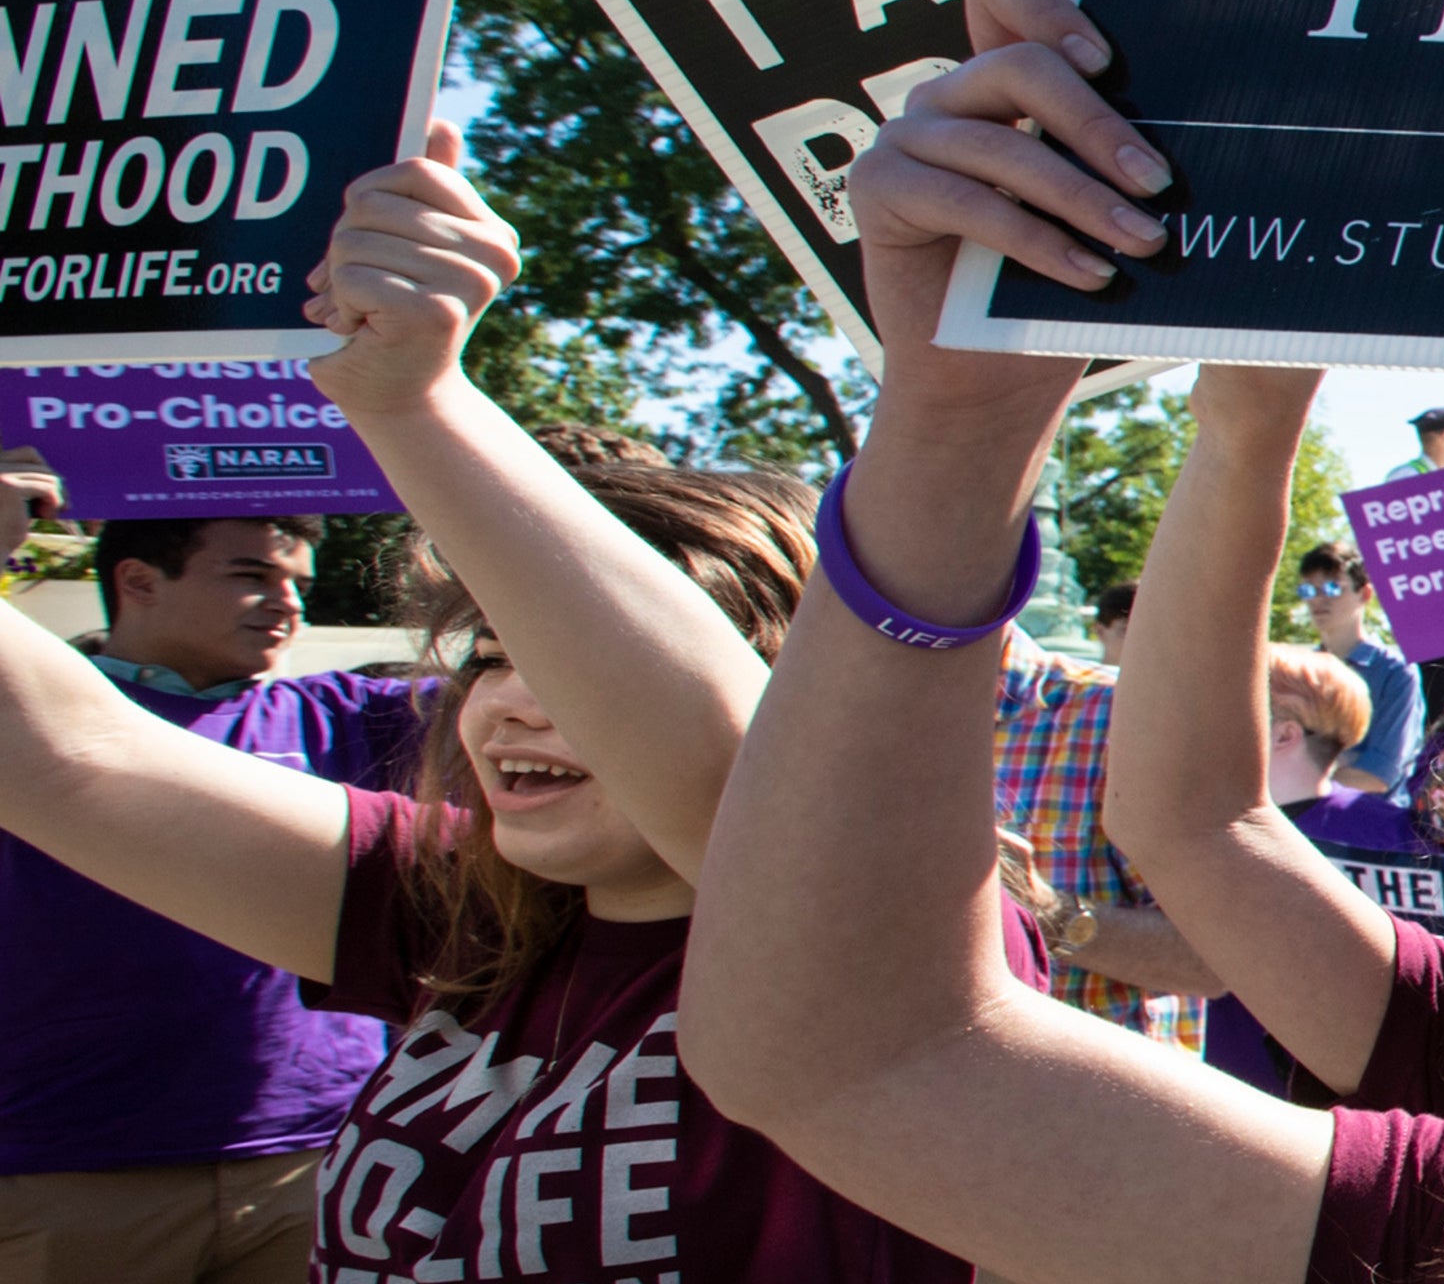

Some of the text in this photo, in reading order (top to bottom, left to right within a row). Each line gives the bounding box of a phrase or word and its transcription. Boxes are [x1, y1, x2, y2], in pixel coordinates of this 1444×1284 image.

[0, 130, 310, 232] THOOD
[0, 249, 283, 304] FORLIFE.ORG
[28, 394, 349, 430] Pro-Choice
[216, 449, 323, 466] NARAL
[1388, 569, 1444, 602] For
[877, 617, 958, 650] LIFE
[1343, 865, 1436, 911] THE
